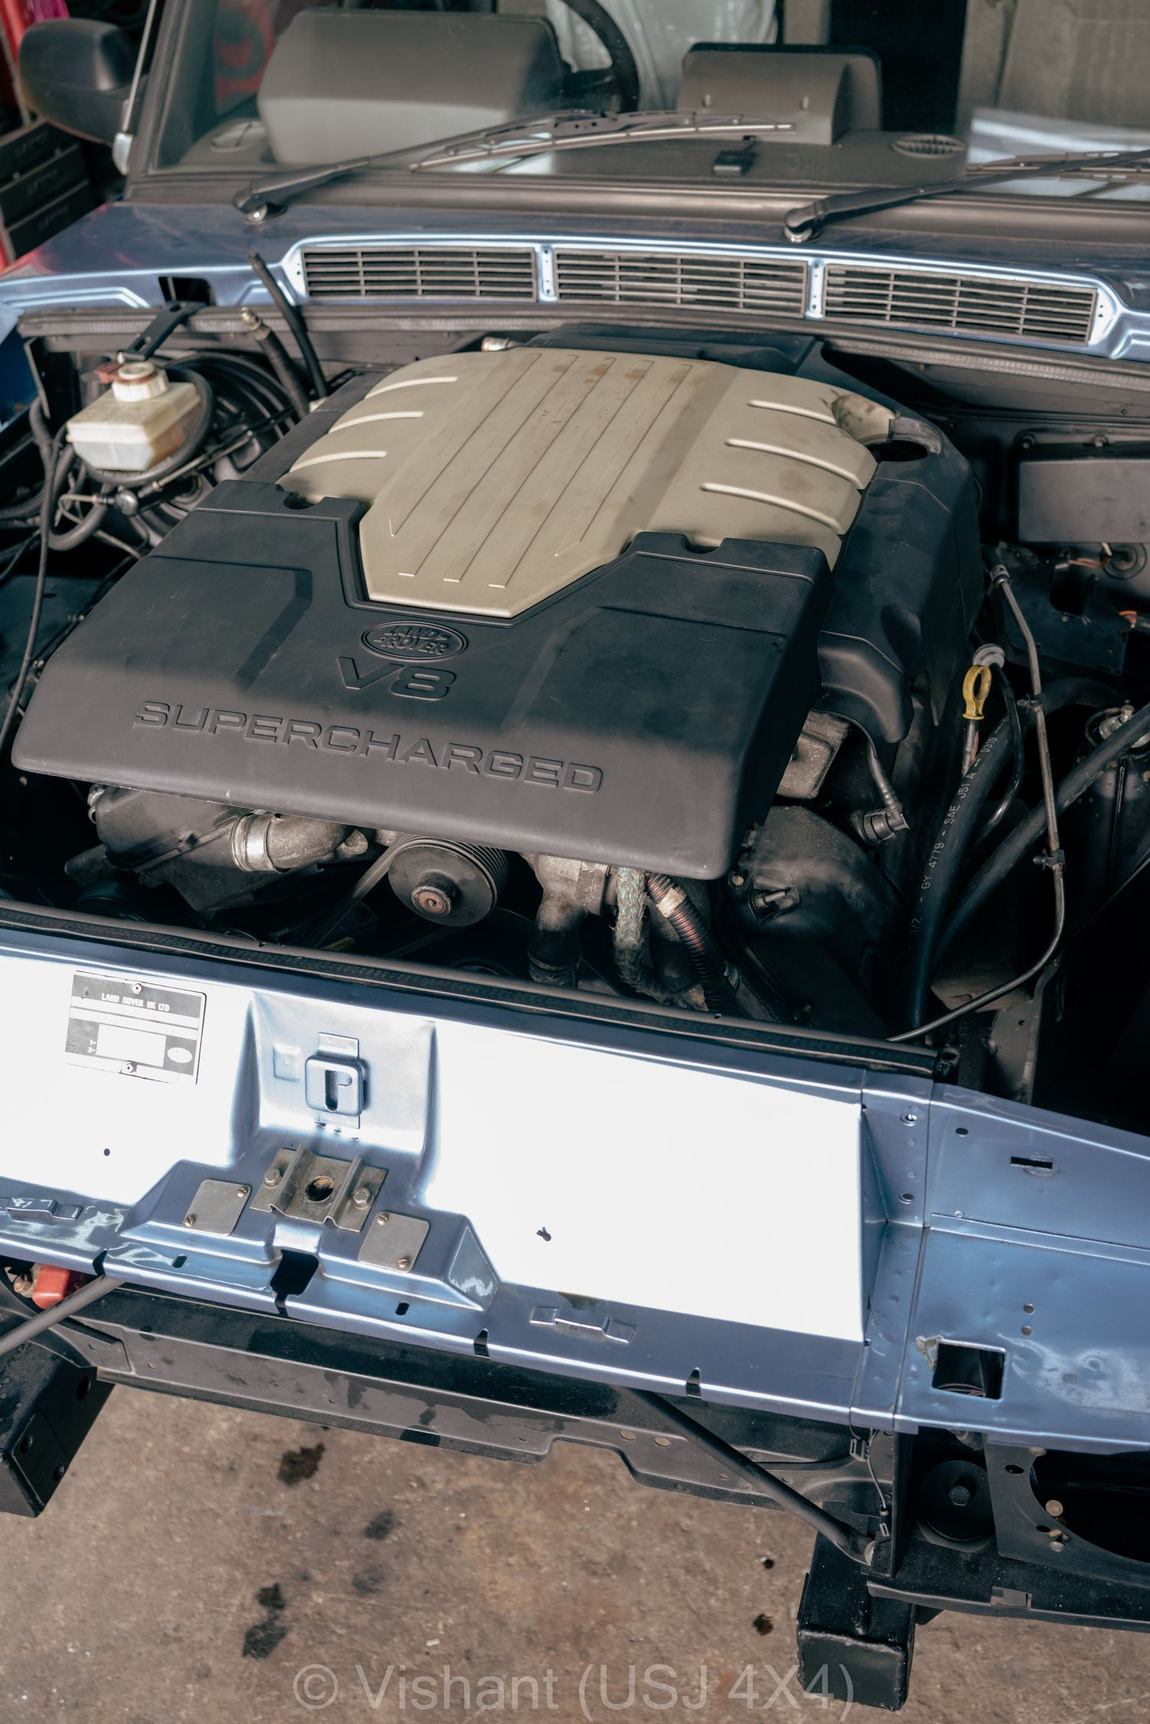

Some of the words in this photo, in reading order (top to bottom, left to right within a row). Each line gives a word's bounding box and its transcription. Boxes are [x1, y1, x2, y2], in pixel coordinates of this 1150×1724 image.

[337, 656, 457, 701] V8
[134, 700, 604, 794] SUPERCHARGED
[921, 875, 931, 890] GY
[944, 804, 960, 825] SAE
[101, 992, 120, 1003] LAND
[122, 997, 144, 1007] ROVER
[158, 1002, 170, 1012] LTD
